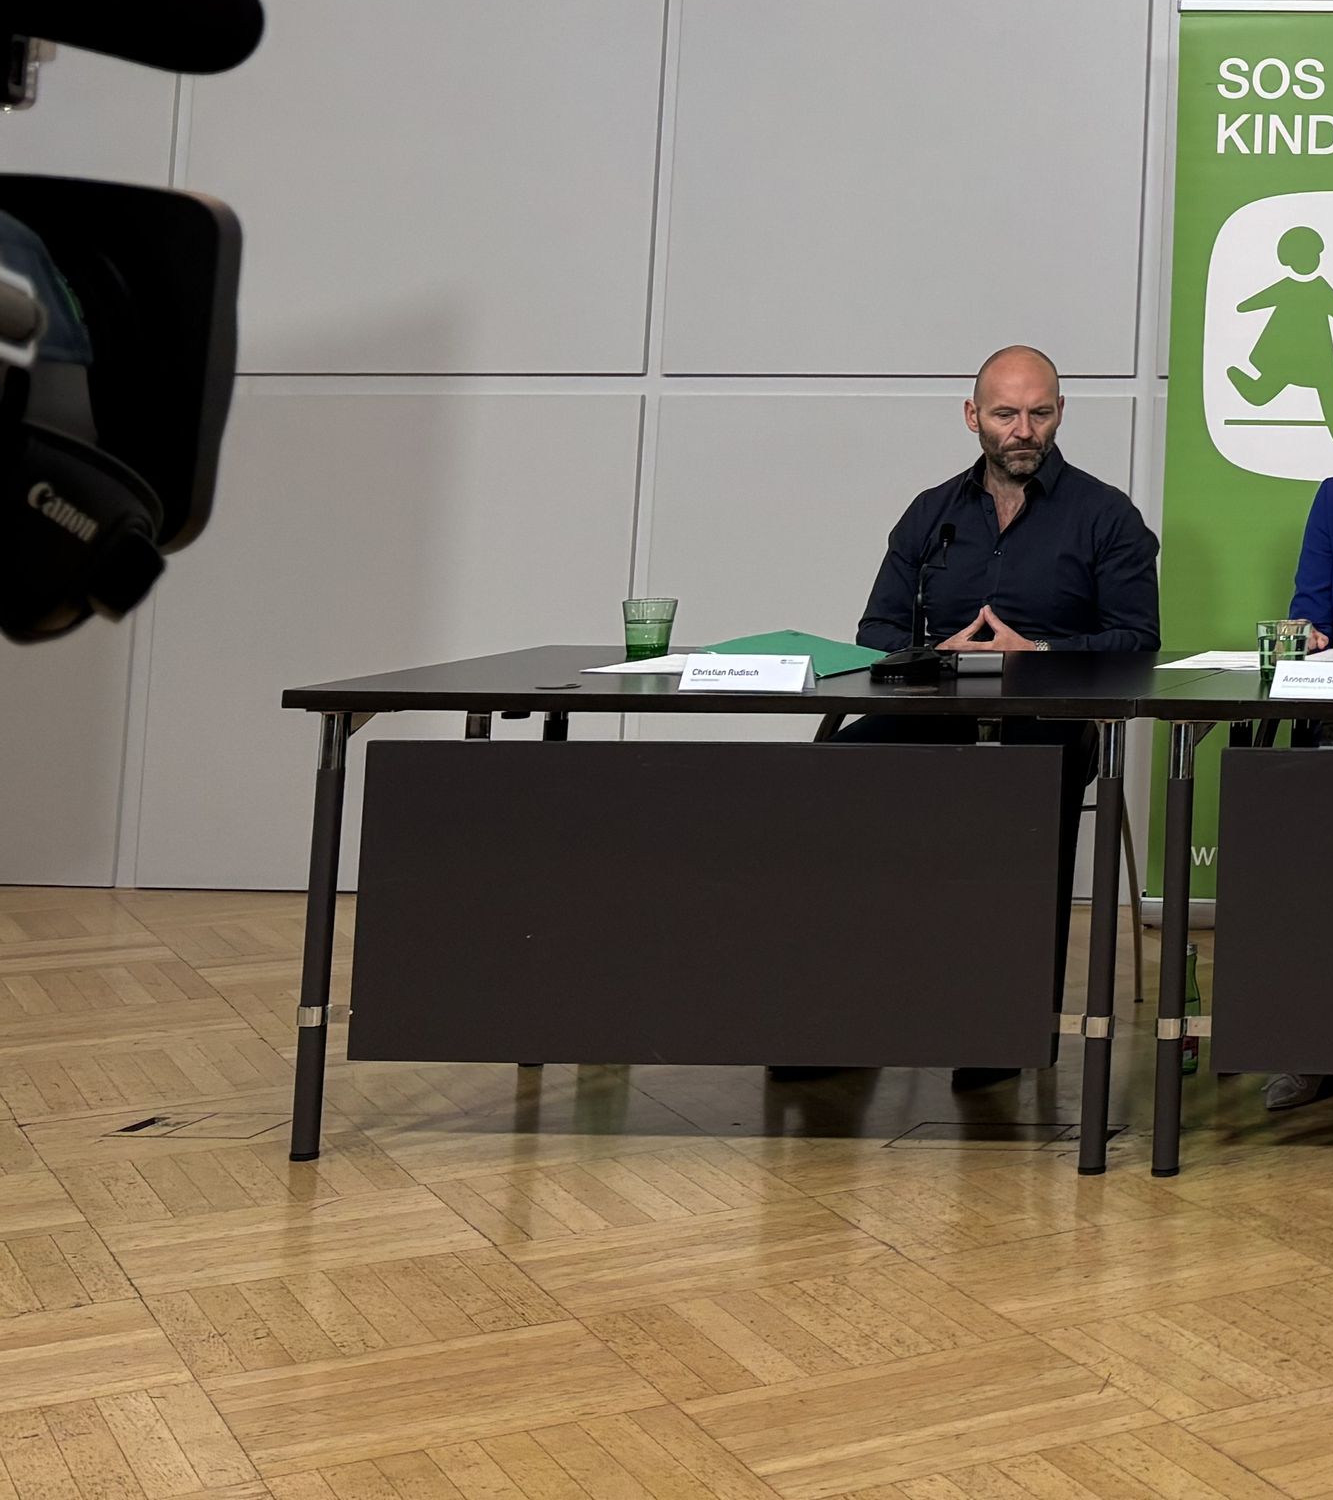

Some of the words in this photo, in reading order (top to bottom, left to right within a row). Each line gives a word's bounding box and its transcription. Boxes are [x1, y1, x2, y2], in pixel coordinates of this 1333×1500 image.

[1216, 57, 1326, 100] SOS
[27, 481, 98, 543] Canon
[692, 668, 727, 676] Christian
